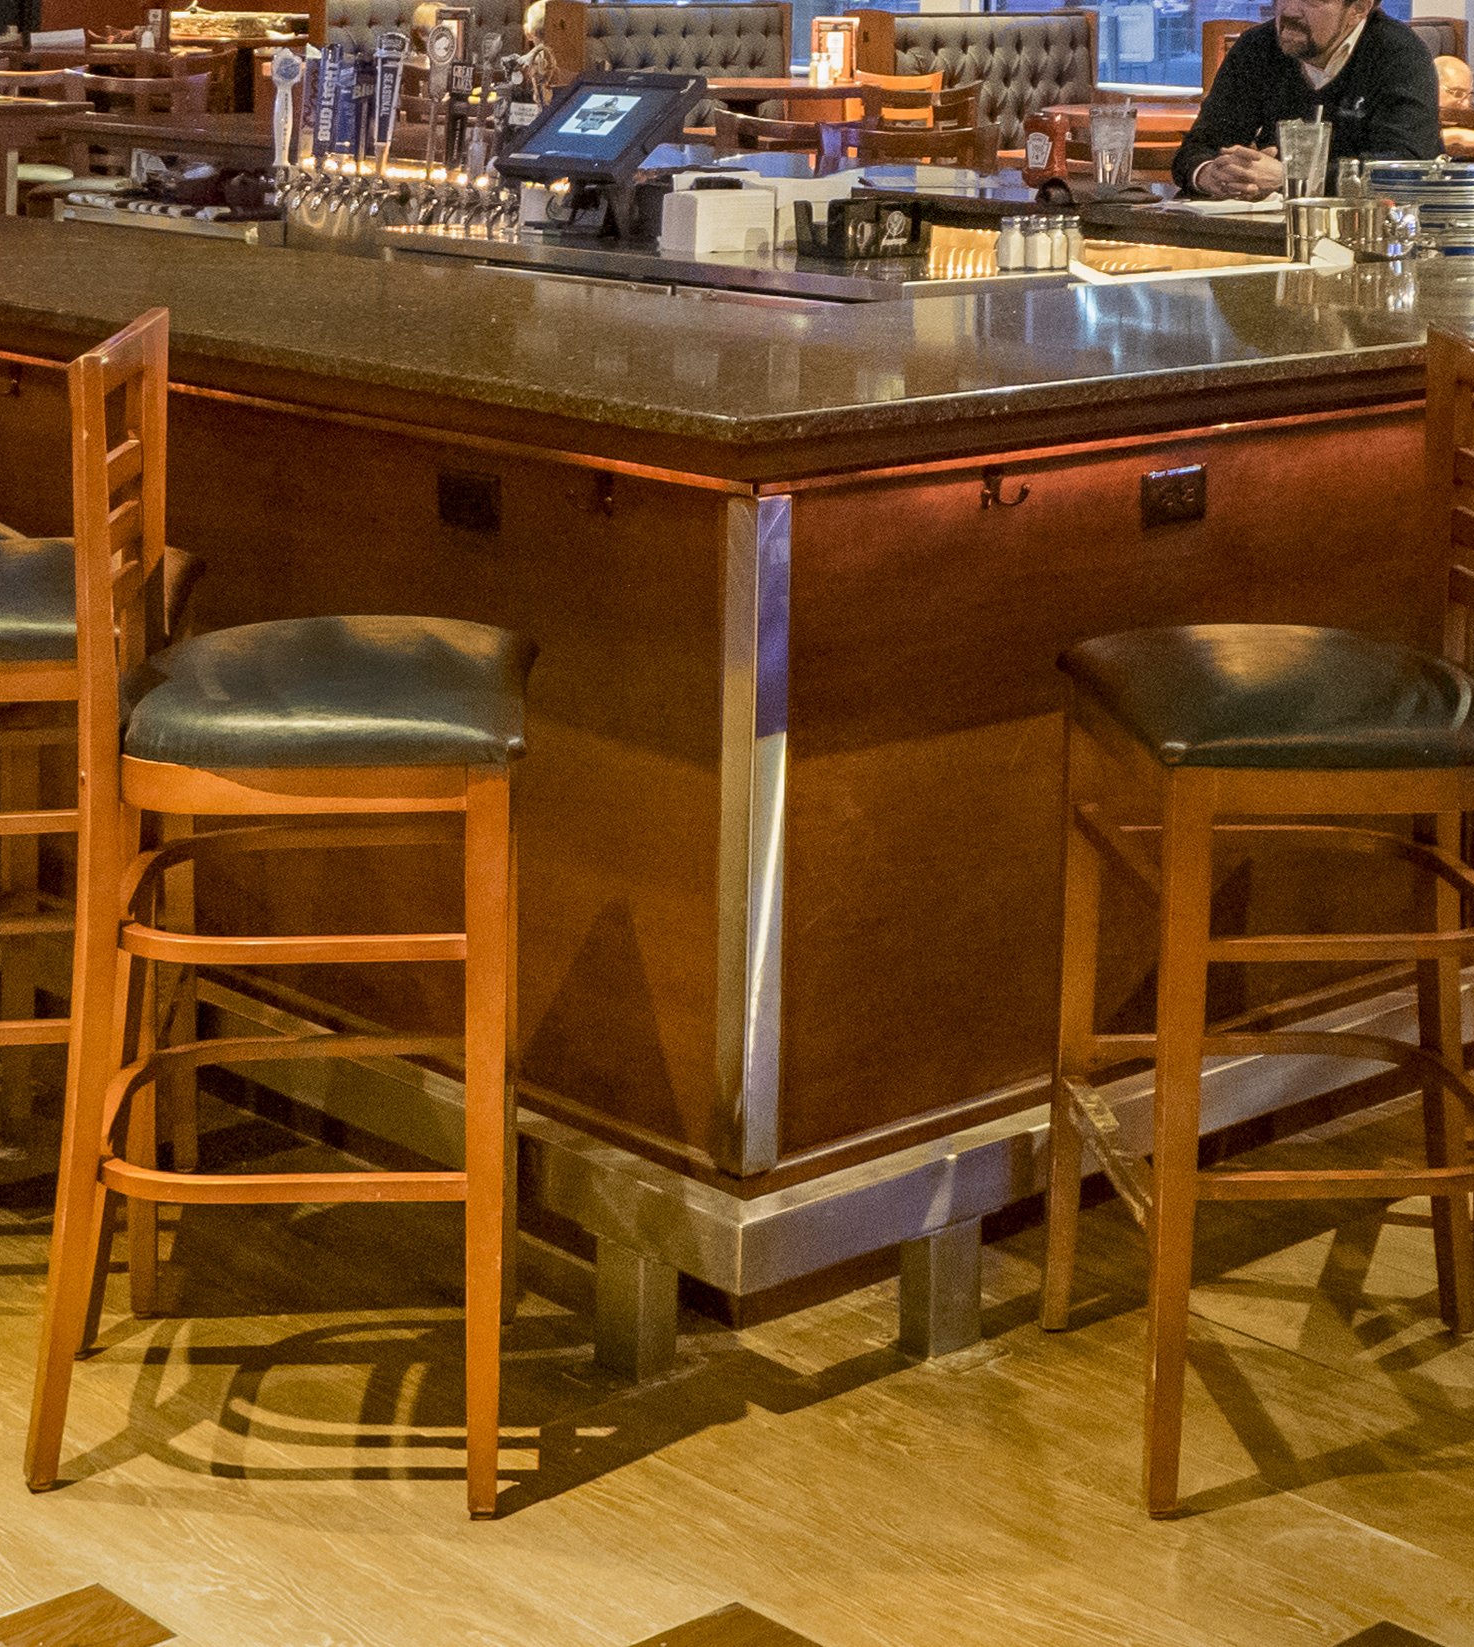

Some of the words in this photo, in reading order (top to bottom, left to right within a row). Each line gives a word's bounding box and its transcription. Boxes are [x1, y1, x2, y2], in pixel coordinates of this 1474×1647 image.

[321, 61, 337, 108] LIGHT
[452, 64, 474, 77] GREAT
[380, 72, 394, 117] SEASONAL
[317, 106, 333, 142] BUD
